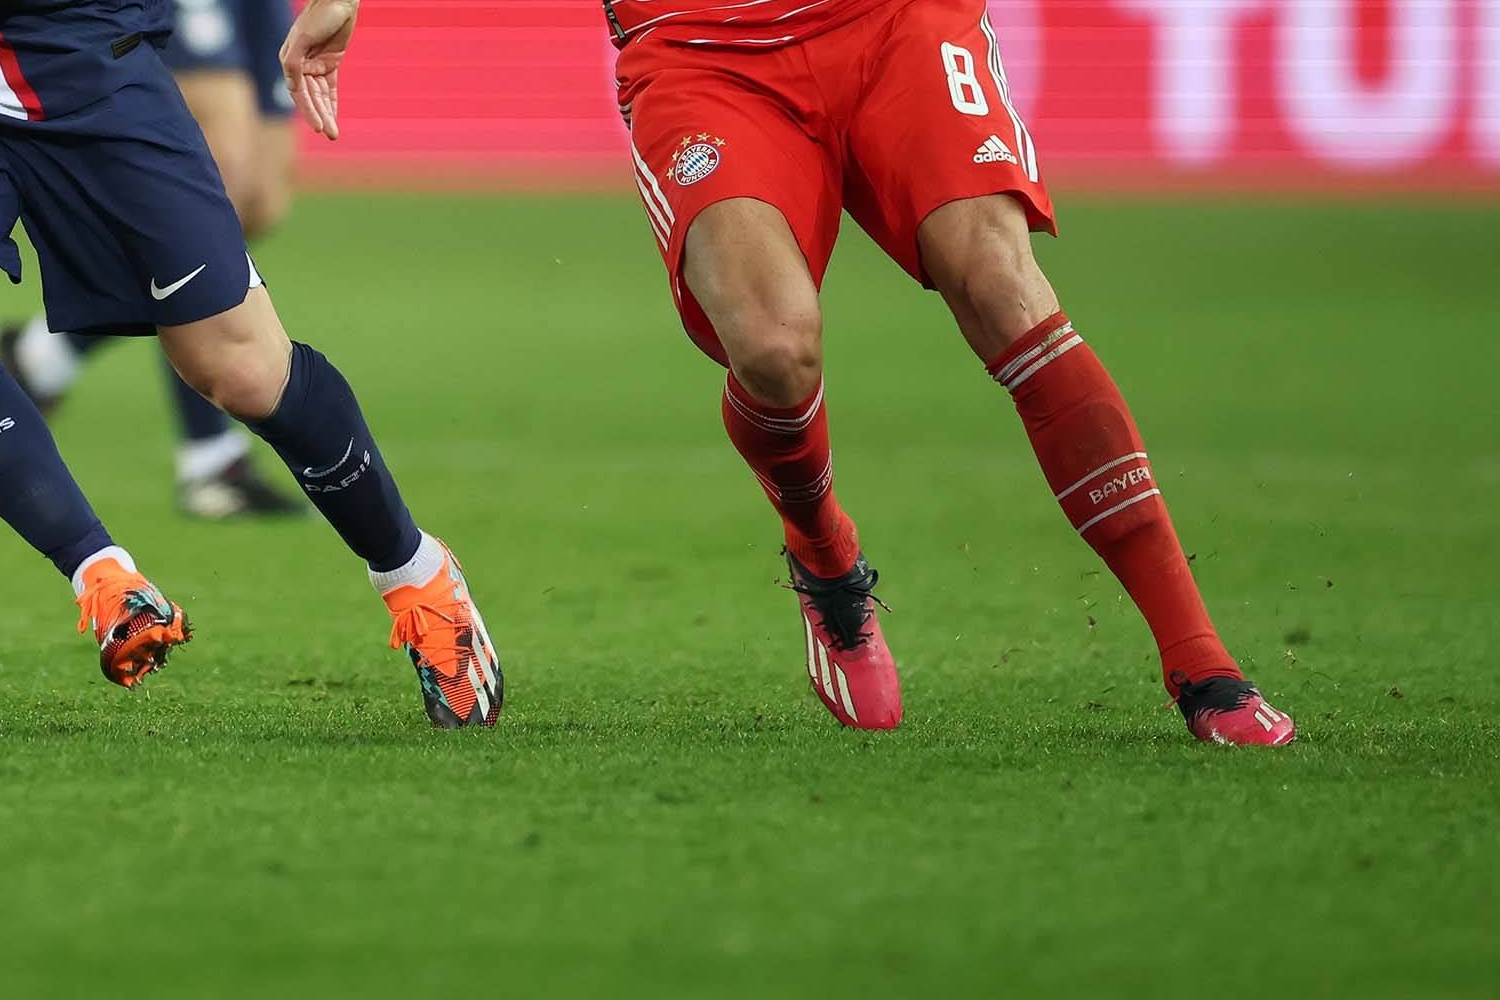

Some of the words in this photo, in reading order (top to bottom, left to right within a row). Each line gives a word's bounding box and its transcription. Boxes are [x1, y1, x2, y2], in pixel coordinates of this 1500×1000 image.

[940, 41, 989, 116] 8
[972, 150, 1018, 165] adidas
[305, 449, 371, 493] PARIS
